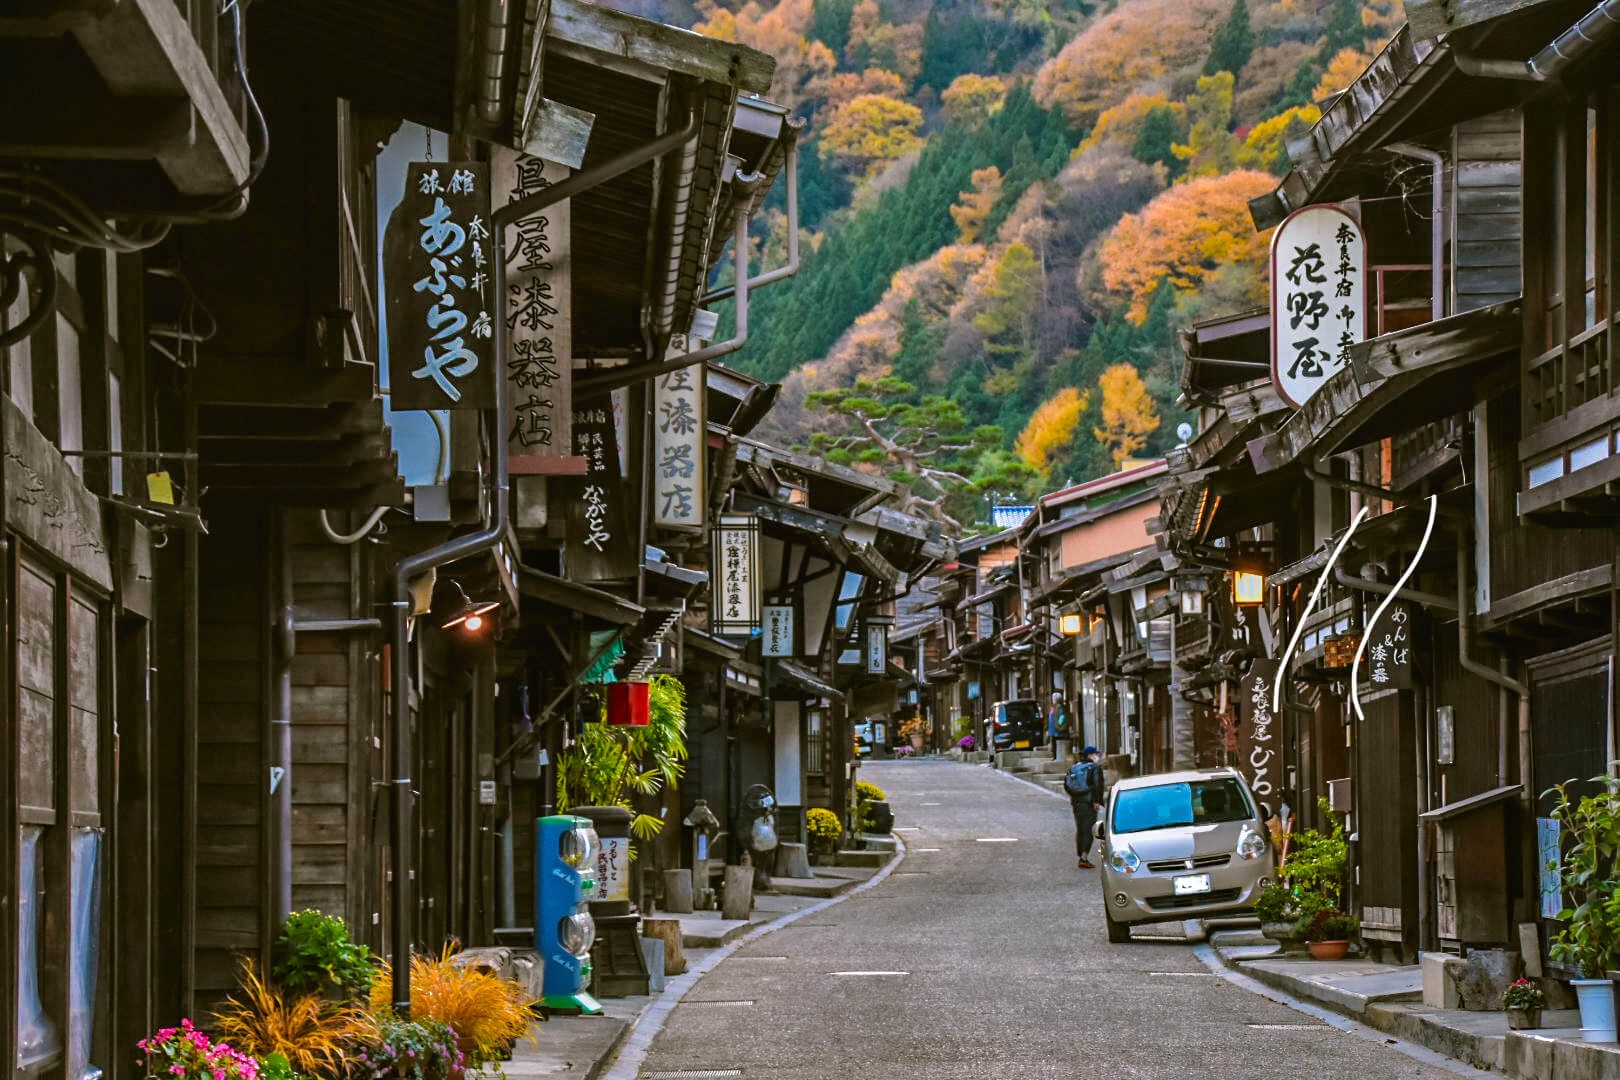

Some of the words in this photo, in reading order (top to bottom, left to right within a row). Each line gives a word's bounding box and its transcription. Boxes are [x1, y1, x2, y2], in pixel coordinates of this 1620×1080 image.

[418, 168, 476, 195] 旅館
[412, 197, 479, 402] あぶらや
[467, 214, 493, 340] 奈良井宿
[1285, 243, 1332, 379] 花野屋
[1333, 222, 1357, 299] 奈良井宿
[582, 484, 612, 552] ながとや
